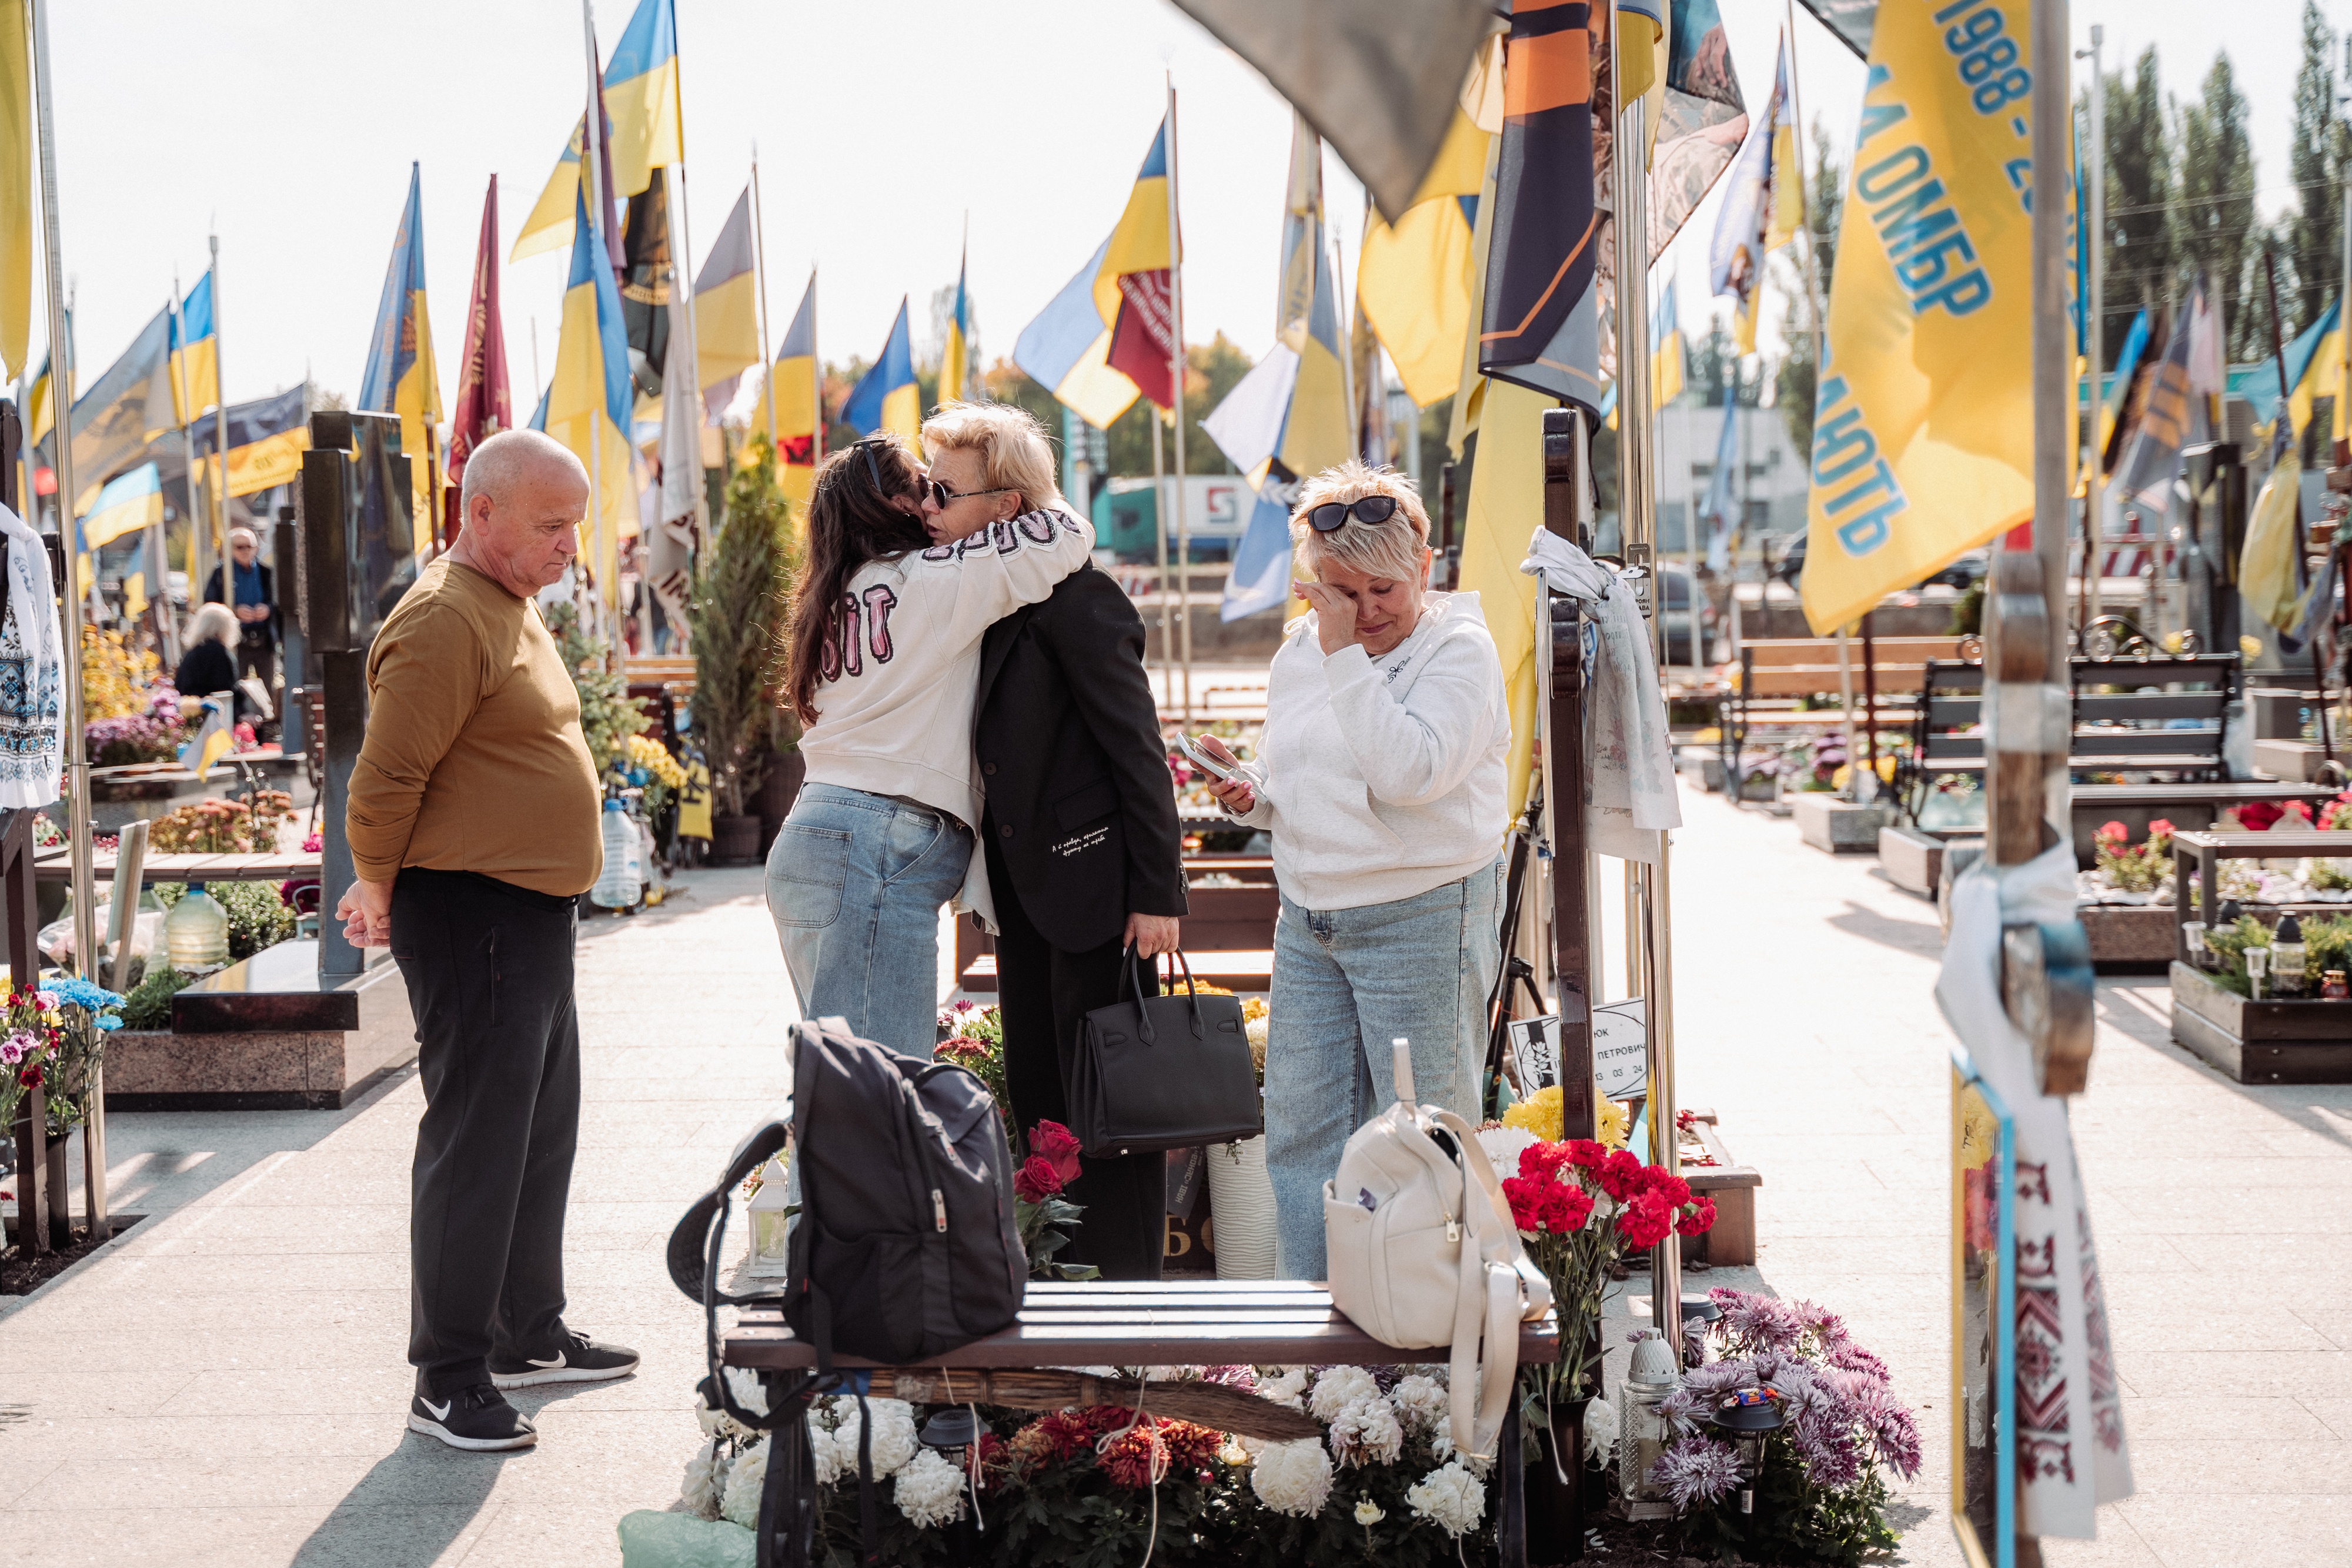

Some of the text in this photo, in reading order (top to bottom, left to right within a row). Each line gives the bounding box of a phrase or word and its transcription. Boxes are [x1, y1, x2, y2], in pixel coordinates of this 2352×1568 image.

[1935, 0, 2032, 115] 1988
[1856, 145, 1992, 317] ОМБР
[1813, 341, 1907, 557] АЮТЬ
[1063, 838, 1081, 848] правда,
[1091, 835, 1105, 845] треба
[1598, 1044, 1646, 1060] ПЕТРОВИЧ
[1595, 1065, 1643, 1081] 13 03 24
